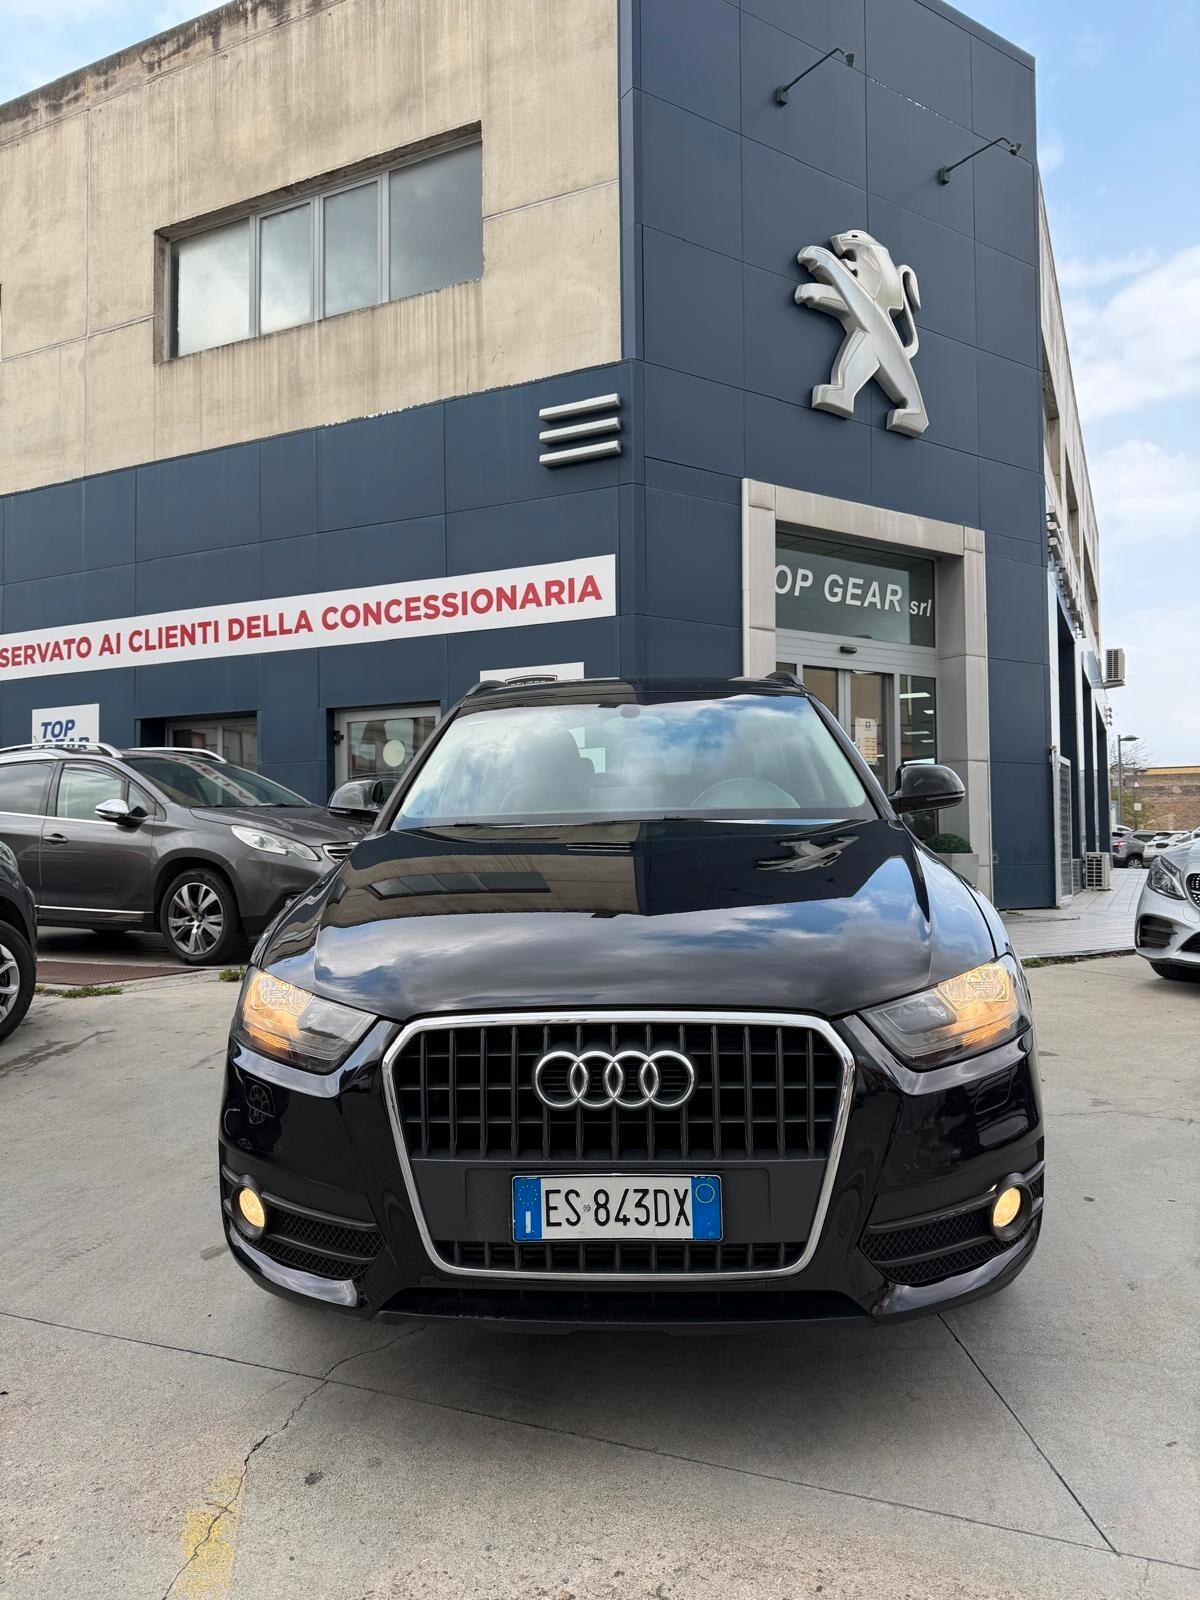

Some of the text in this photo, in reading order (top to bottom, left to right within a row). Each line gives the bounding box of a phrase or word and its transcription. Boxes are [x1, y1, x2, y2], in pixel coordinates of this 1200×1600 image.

[823, 573, 903, 612] GEAR
[909, 599, 932, 617] srl
[0, 574, 604, 668] SERVATO AI CLIENTI DELLA CONCESSIONARIA
[40, 719, 76, 739] TOP
